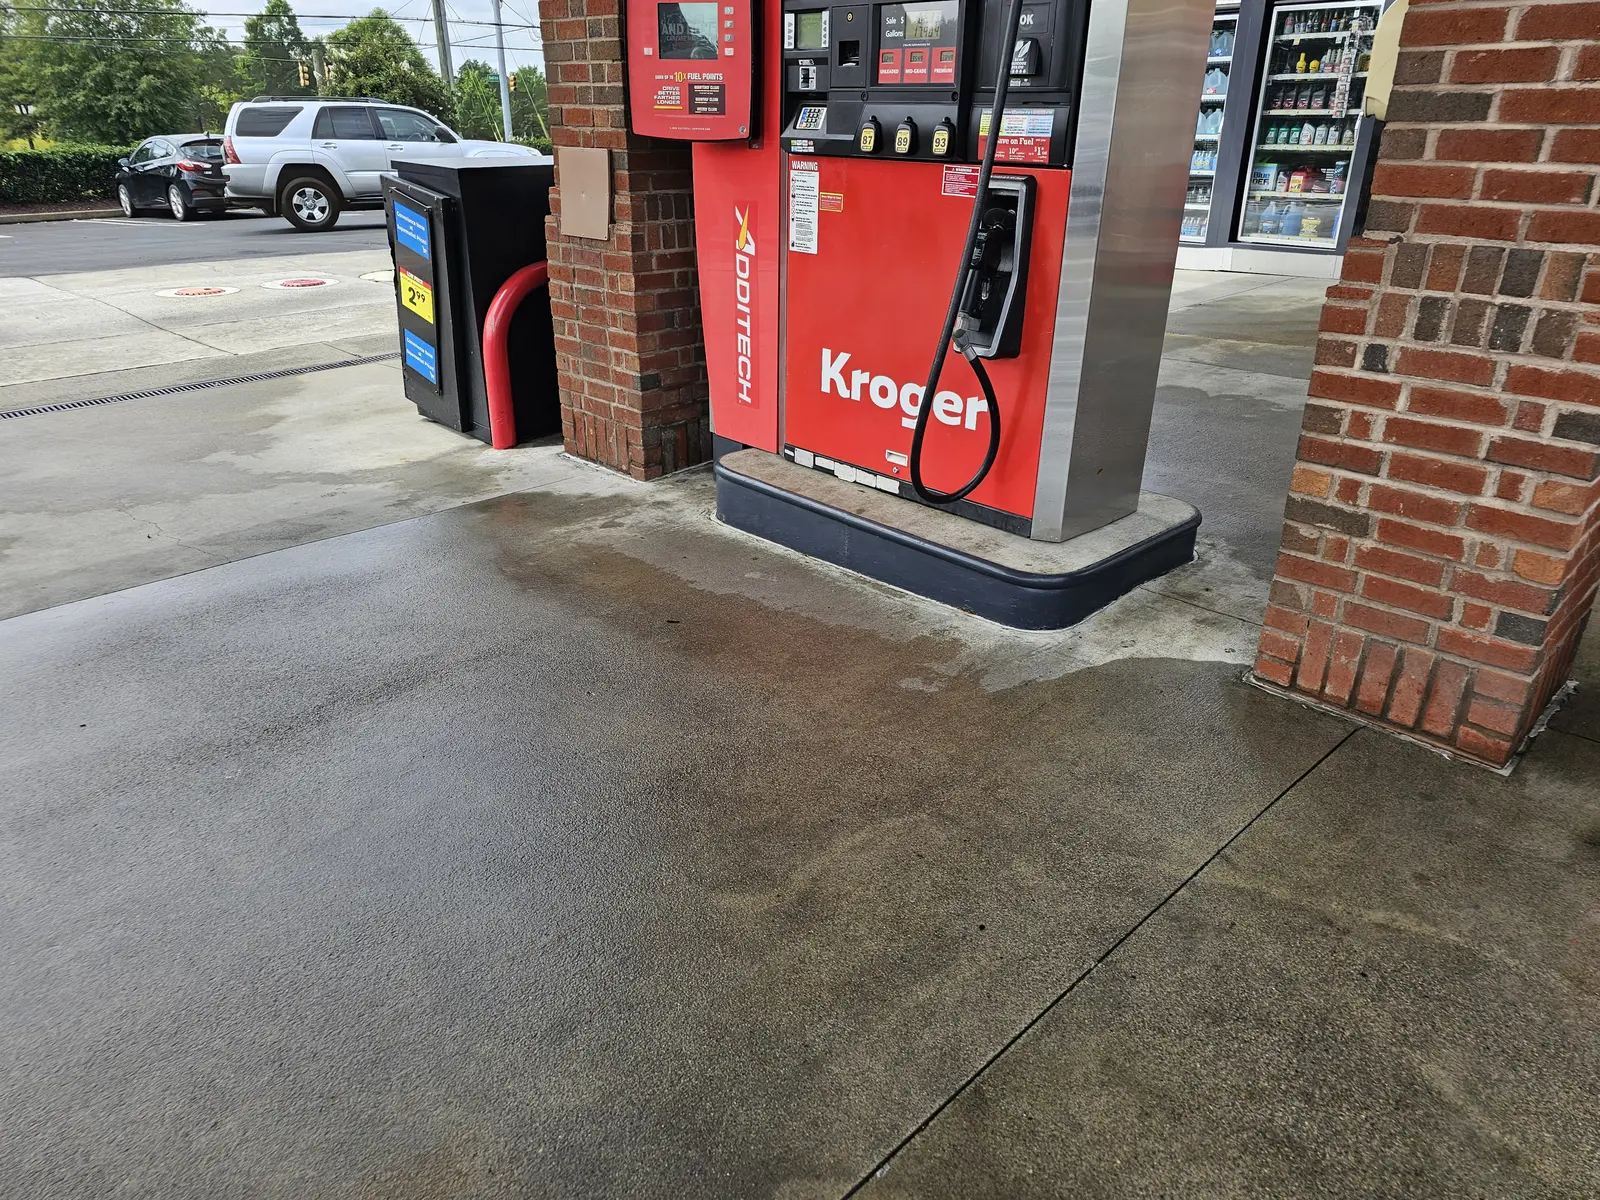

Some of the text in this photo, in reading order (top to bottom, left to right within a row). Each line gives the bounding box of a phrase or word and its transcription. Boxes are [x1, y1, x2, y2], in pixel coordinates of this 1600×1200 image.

[1019, 14, 1034, 25] OK
[886, 29, 903, 38] Gallons
[702, 73, 723, 81] POINTS
[862, 136, 873, 145] 87
[897, 137, 908, 147] 89
[935, 138, 946, 147] 93
[1019, 137, 1034, 146] Fuel
[791, 160, 818, 171] WARNING
[1253, 171, 1271, 179] Blue
[821, 348, 989, 431] Kroger
